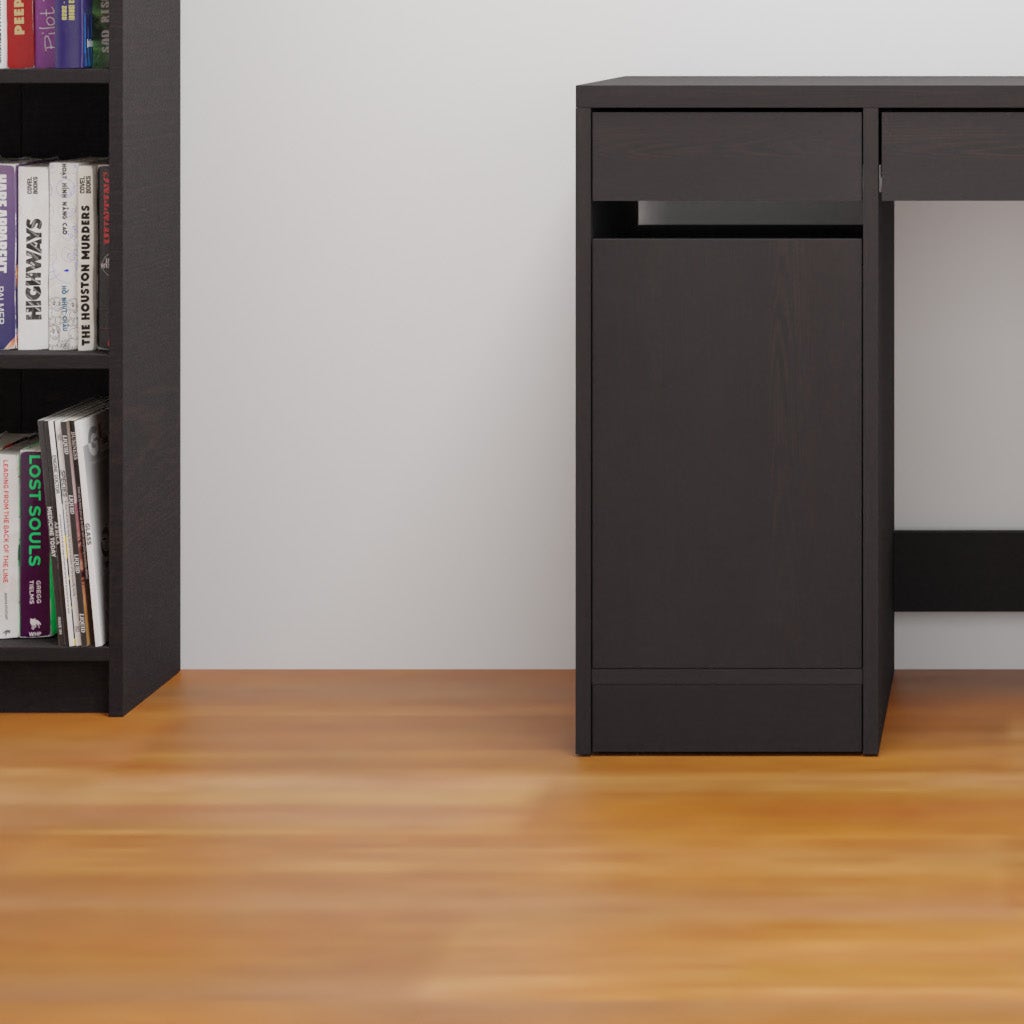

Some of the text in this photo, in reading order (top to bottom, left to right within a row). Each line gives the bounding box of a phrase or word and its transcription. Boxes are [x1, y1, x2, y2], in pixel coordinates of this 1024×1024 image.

[39, 7, 55, 52] Pilot
[100, 29, 109, 53] SAD
[26, 218, 42, 320] HIGHWAYS
[81, 205, 90, 346] THE HOUSTON MURDERS
[29, 455, 41, 567] LOST SOULS
[3, 544, 9, 554] OF
